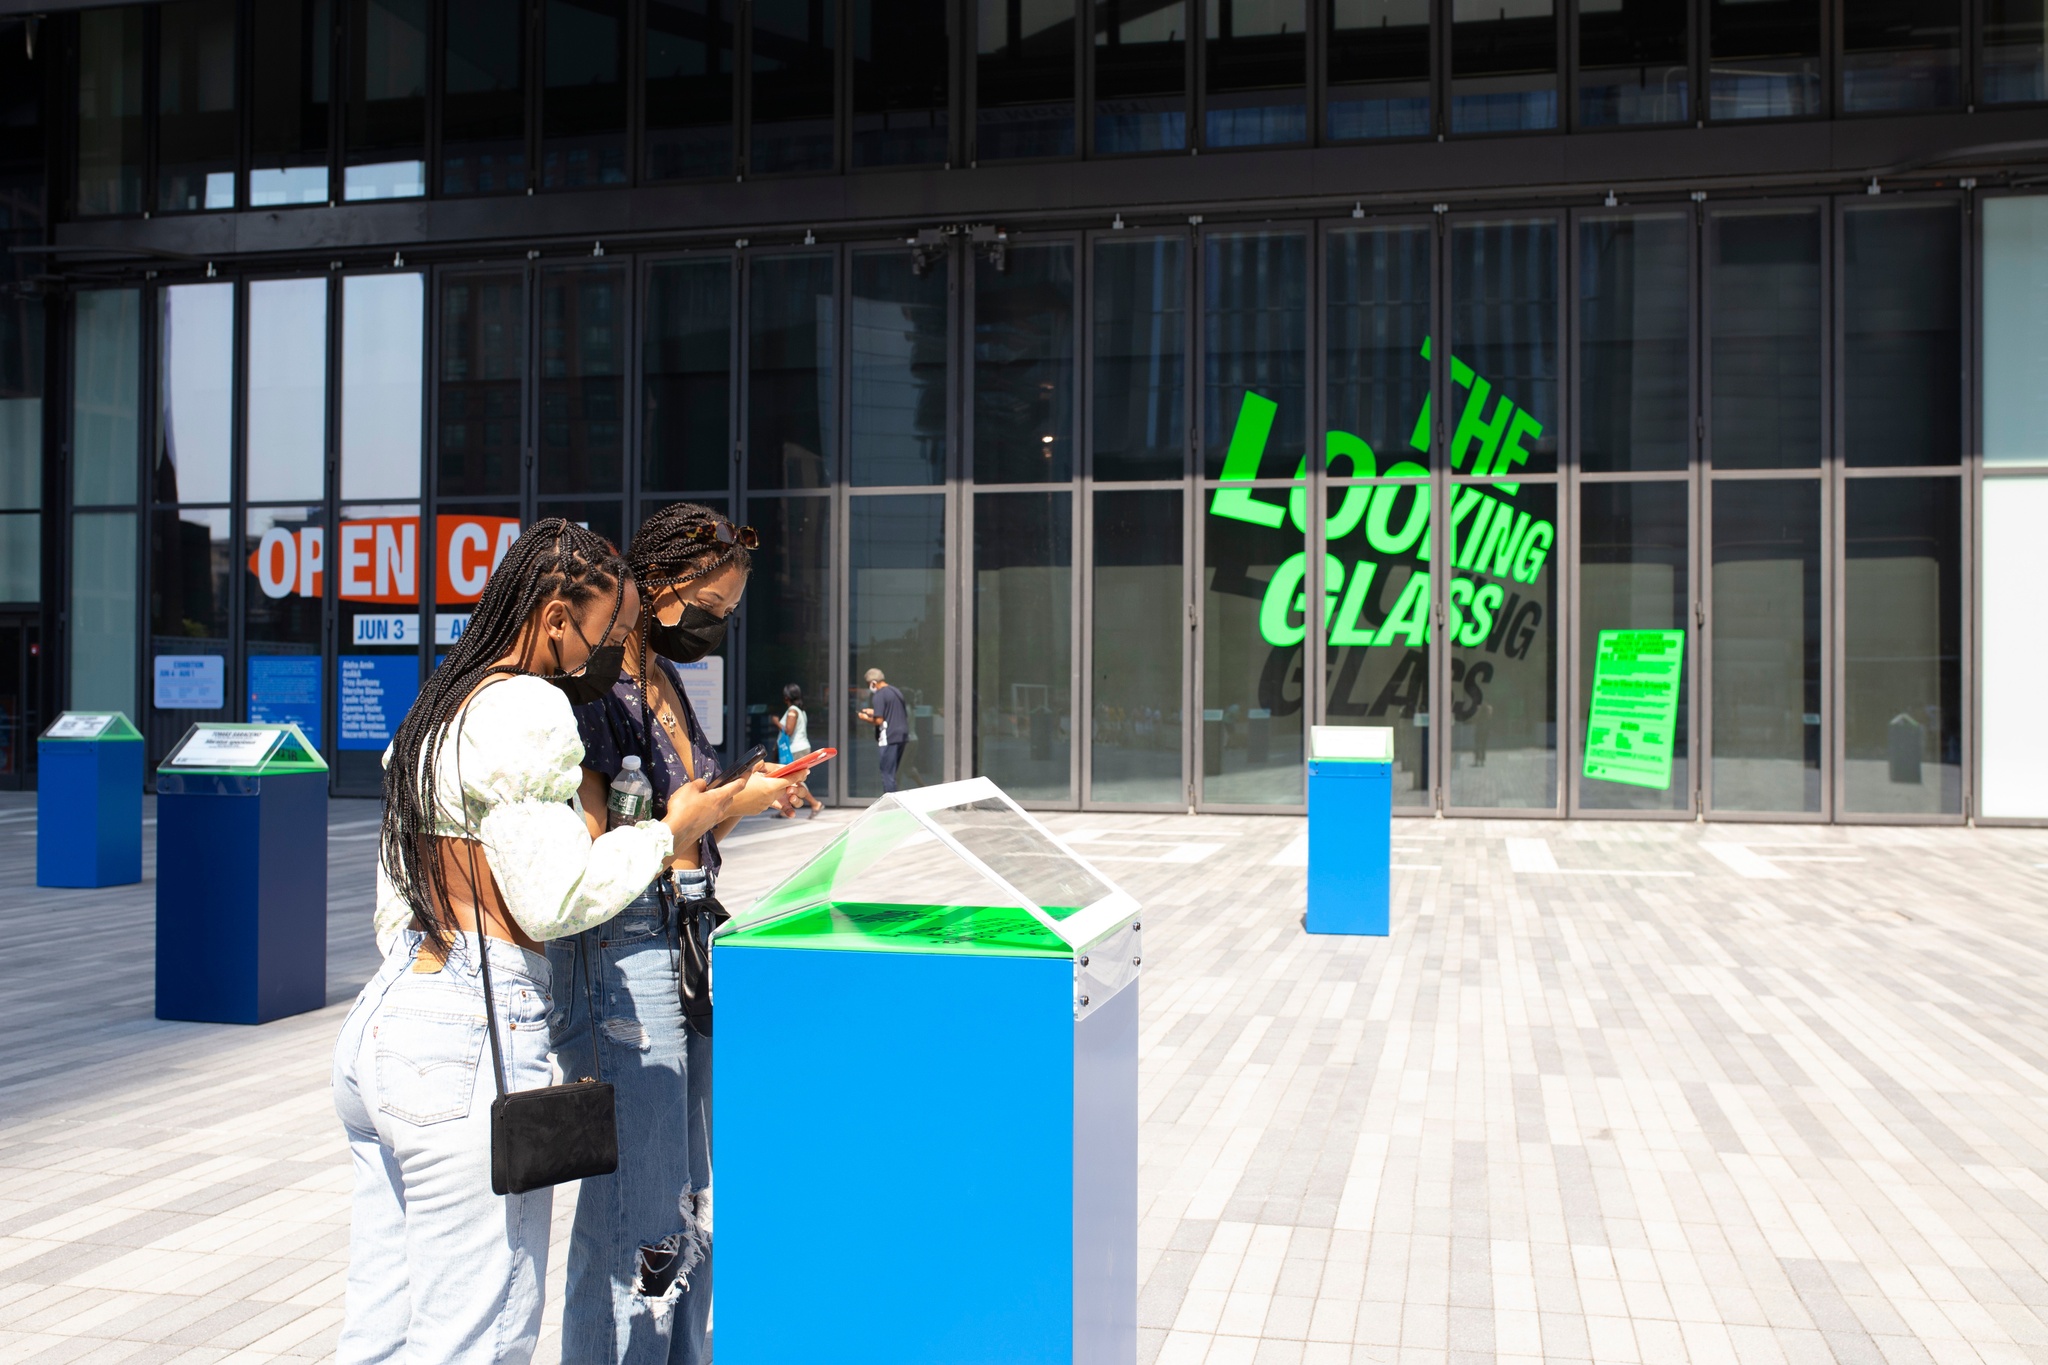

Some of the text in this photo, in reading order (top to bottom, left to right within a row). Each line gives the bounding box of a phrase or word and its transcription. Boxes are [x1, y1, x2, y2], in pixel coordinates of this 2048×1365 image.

[1410, 335, 1543, 496] THE
[1210, 391, 1554, 584] LOOKING
[257, 523, 416, 599] OPEN
[1259, 551, 1504, 648] GLASS
[358, 619, 388, 640] JUN
[393, 619, 404, 639] 3
